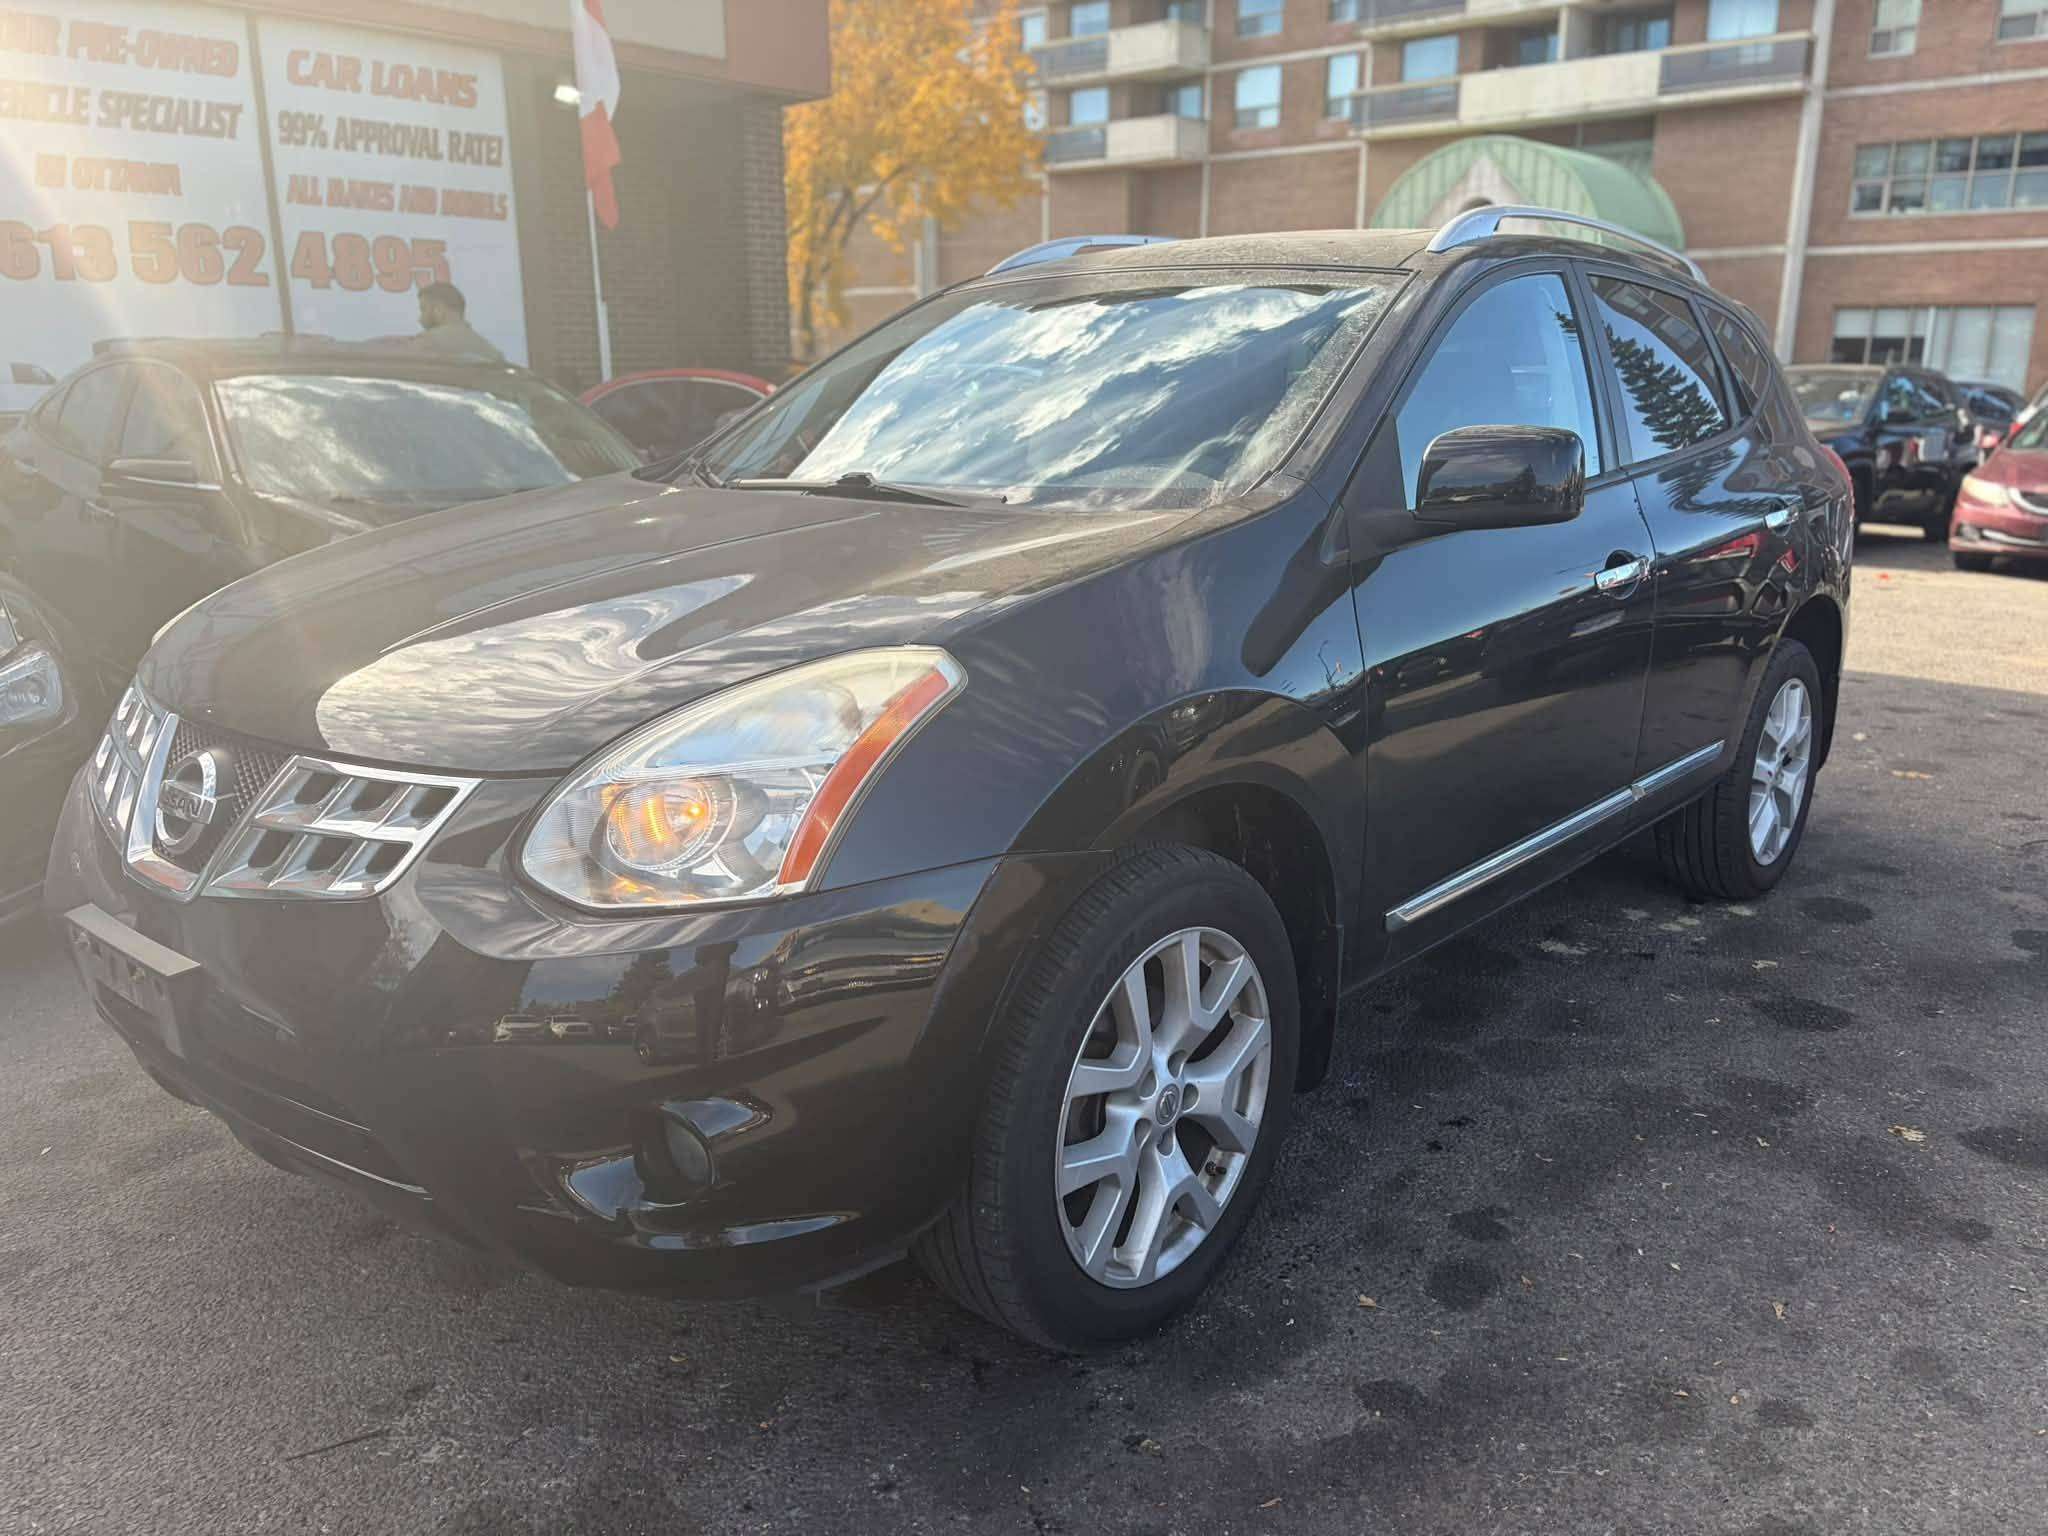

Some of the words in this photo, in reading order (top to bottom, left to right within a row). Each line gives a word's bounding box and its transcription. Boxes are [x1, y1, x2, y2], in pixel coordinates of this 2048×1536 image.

[66, 20, 239, 78] PRE-OWNED
[287, 49, 363, 93] CAR
[370, 61, 478, 108] LOANS
[97, 89, 243, 139] SPECIALIST
[278, 110, 328, 148] 99%
[334, 116, 443, 161] APPROVAL
[0, 220, 117, 282] 613
[128, 220, 270, 288] 562
[291, 231, 452, 293] 4895
